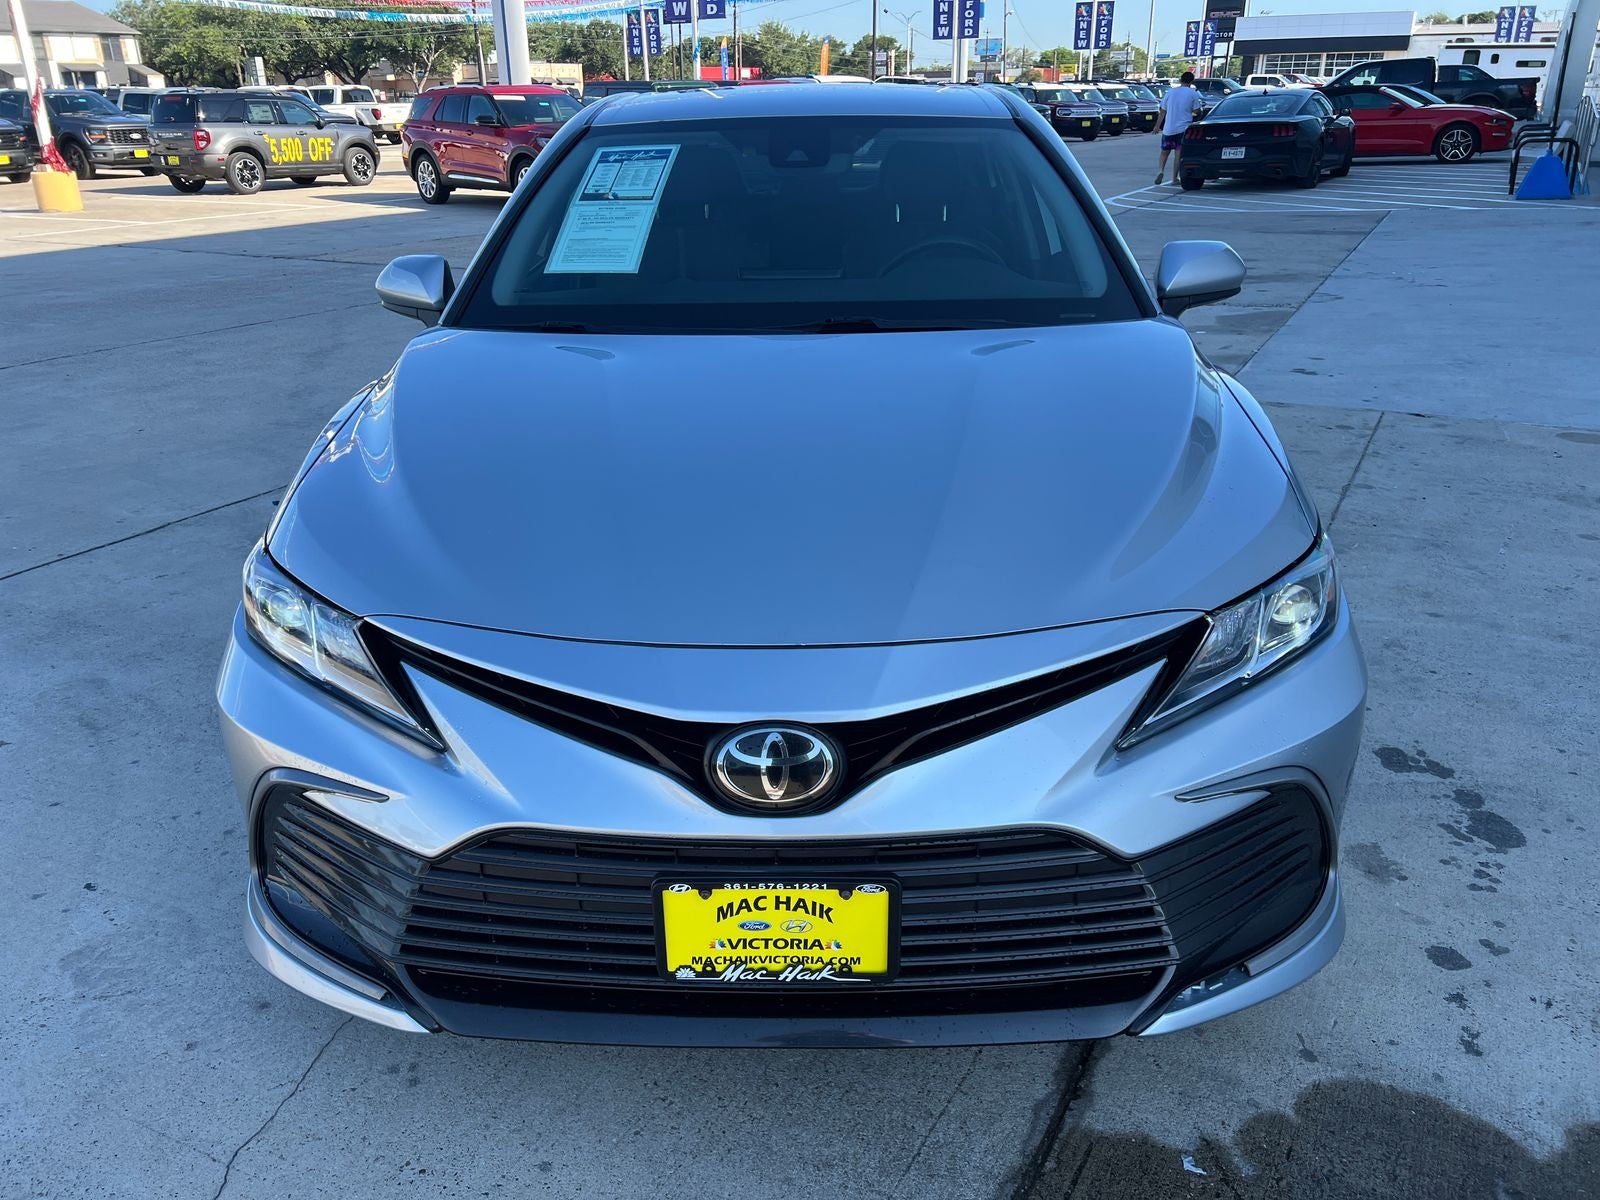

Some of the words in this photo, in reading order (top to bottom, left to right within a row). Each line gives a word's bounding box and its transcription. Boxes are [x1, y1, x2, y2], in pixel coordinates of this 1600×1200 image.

[938, 2, 949, 37] NEW
[964, 1, 974, 36] FORD
[1498, 21, 1509, 43] NEW
[632, 28, 641, 55] NEW
[650, 27, 658, 54] FORD
[1077, 21, 1088, 48] NEW
[1098, 20, 1108, 47] FORD
[1187, 35, 1196, 55] NEW
[1204, 34, 1212, 55] FORD
[262, 134, 304, 165] $5,500
[309, 137, 333, 161] OFF
[716, 895, 768, 923] MAC
[774, 895, 834, 924] HAIK
[726, 938, 825, 951] VICTORIA
[720, 963, 771, 982] Mac
[778, 964, 846, 982] Haik
